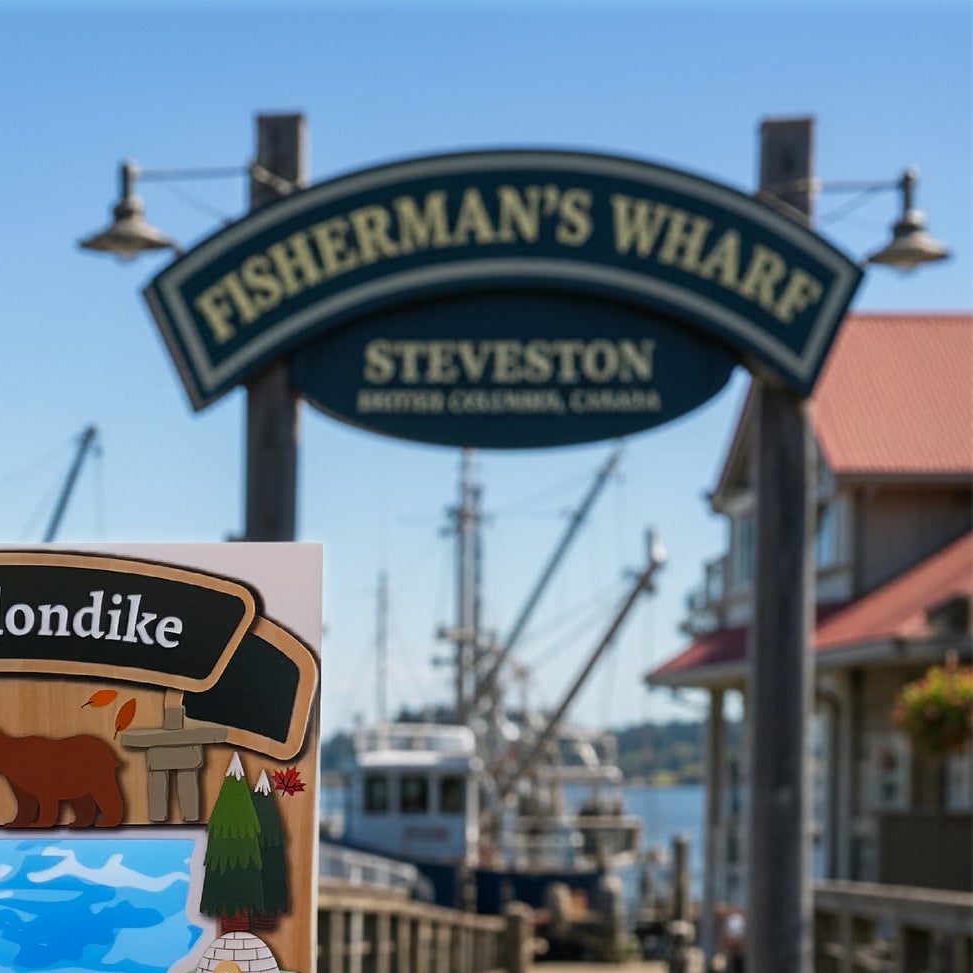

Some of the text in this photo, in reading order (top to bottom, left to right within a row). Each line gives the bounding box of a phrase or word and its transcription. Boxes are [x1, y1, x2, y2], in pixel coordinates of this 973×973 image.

[194, 184, 824, 345] FISHERMAN'S WHARF
[363, 338, 656, 385] STEVESTON
